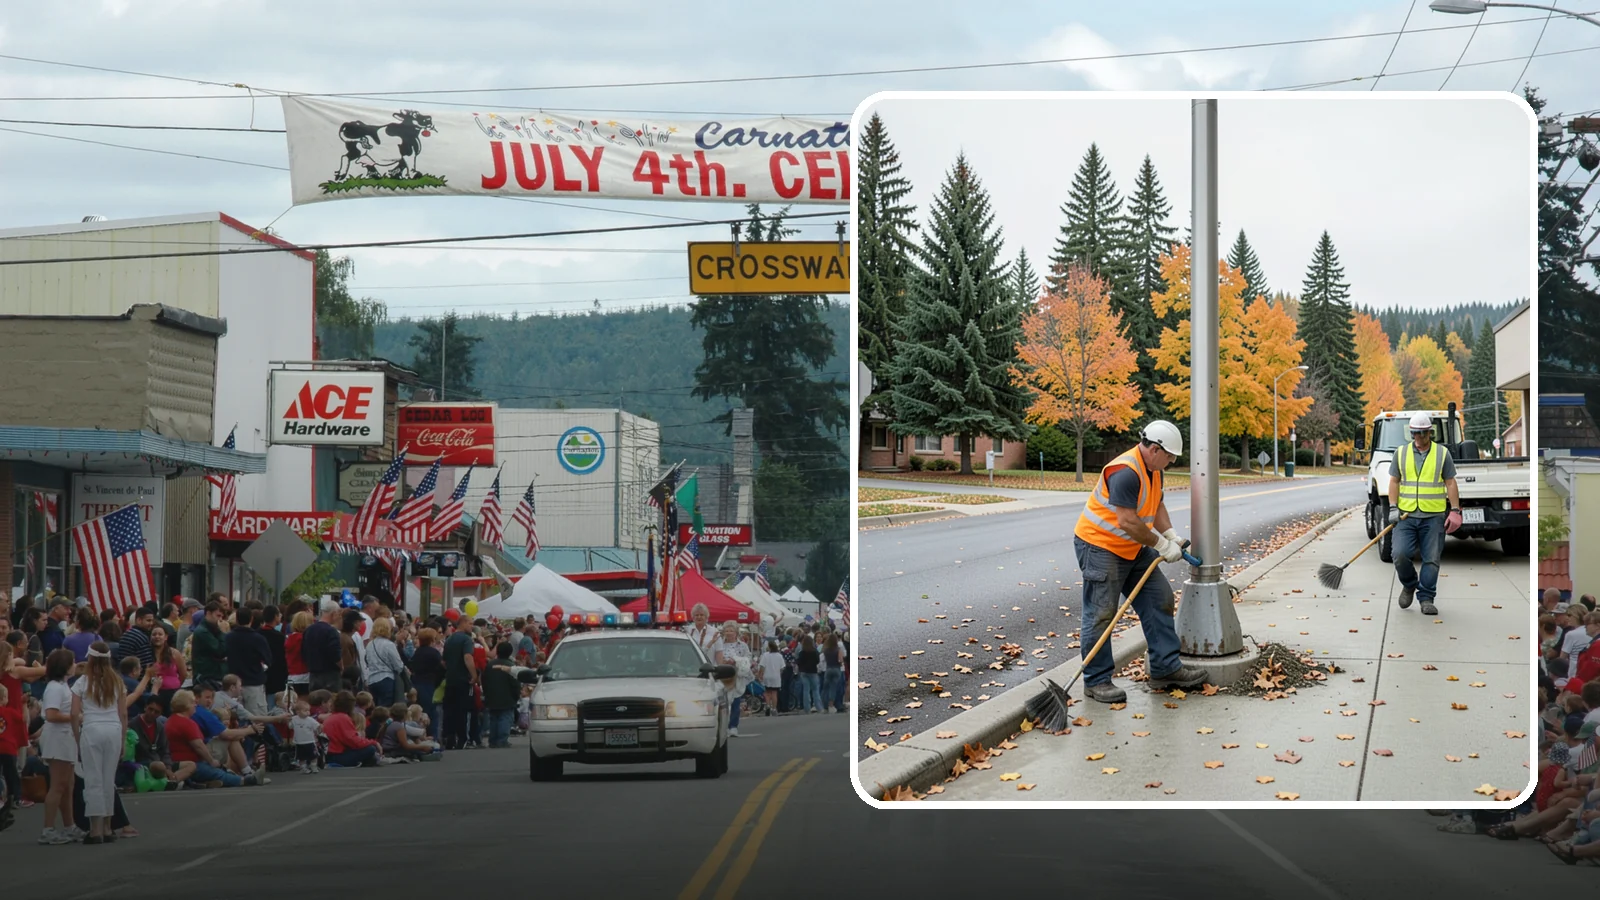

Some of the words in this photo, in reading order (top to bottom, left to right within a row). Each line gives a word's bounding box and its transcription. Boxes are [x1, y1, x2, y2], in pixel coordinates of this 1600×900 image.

[481, 141, 605, 193] JULY
[632, 150, 746, 198] 4th.
[697, 254, 850, 280] CROSSWA
[282, 380, 374, 420] ACE
[405, 408, 452, 422] CEDAR
[283, 421, 371, 436] Hardware
[416, 428, 476, 447] Coca-Cola
[353, 467, 385, 479] Simpl
[96, 485, 124, 495] Vincent
[126, 486, 135, 495] de
[137, 486, 155, 495] Paul
[212, 516, 331, 536] HARDARE
[688, 526, 741, 535] CRNATION
[699, 535, 730, 543] GLASS
